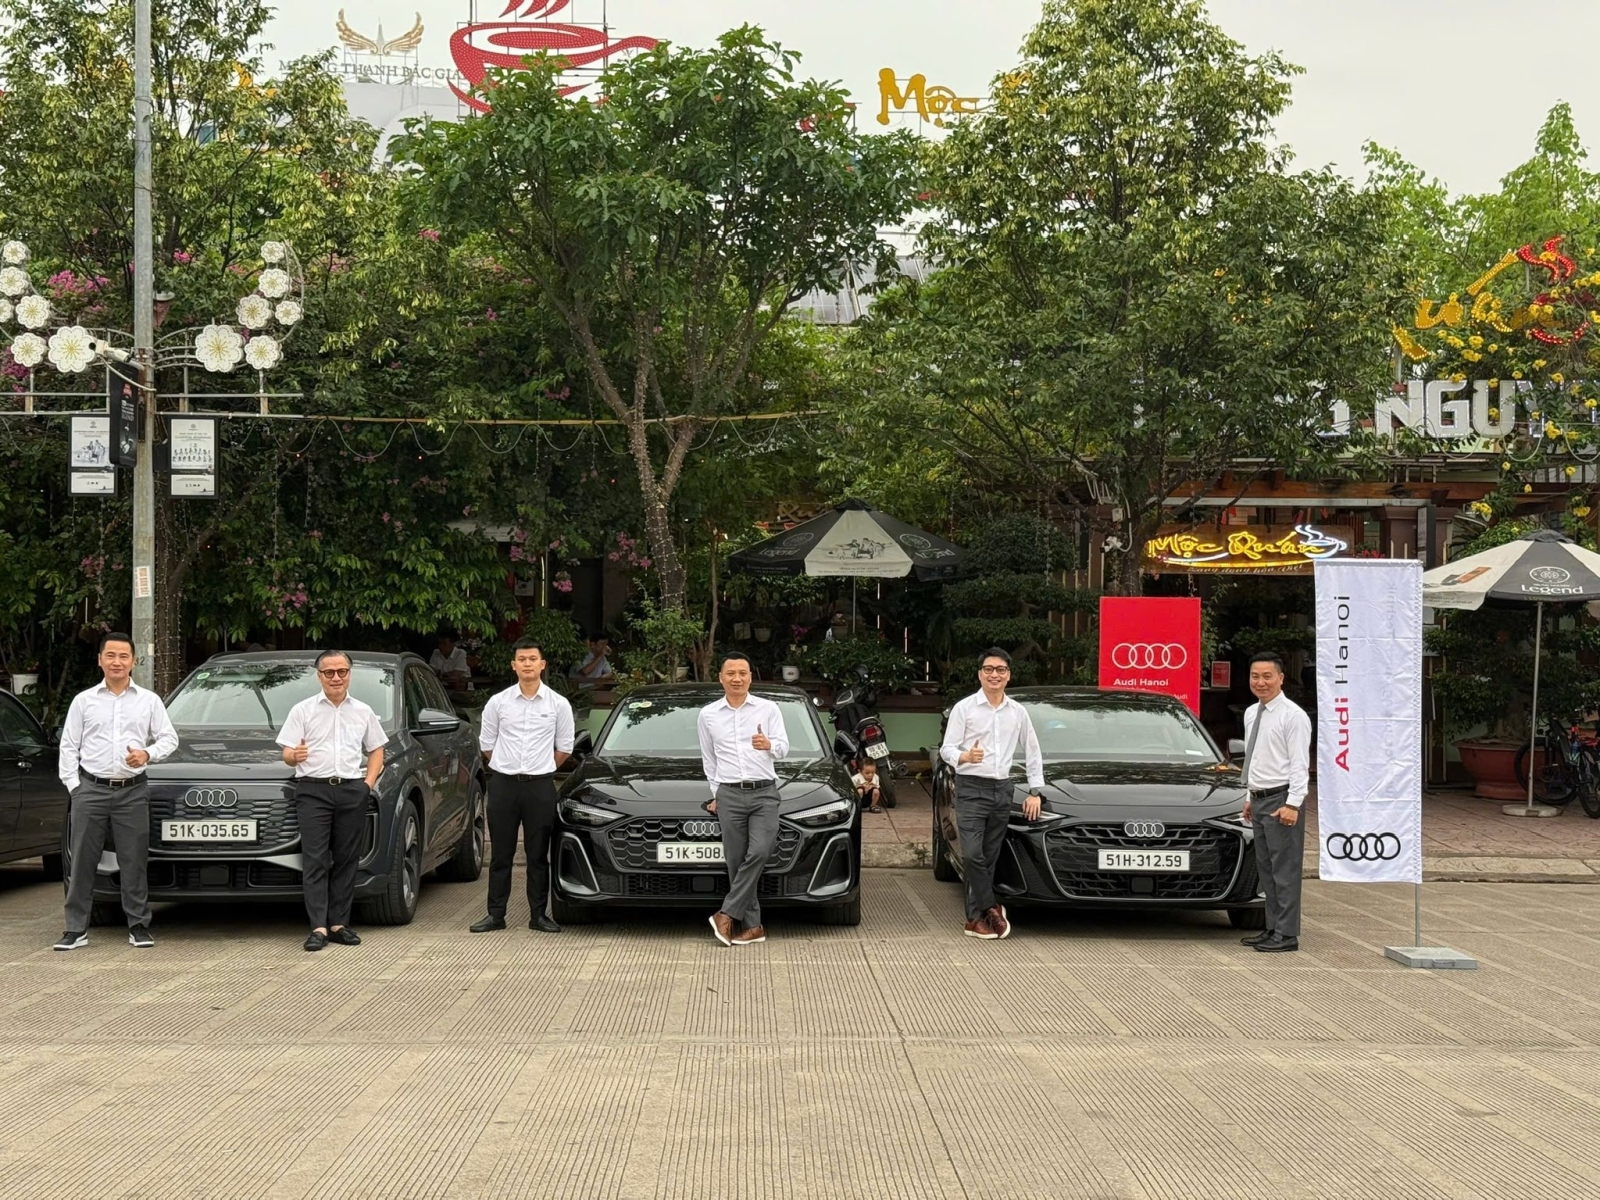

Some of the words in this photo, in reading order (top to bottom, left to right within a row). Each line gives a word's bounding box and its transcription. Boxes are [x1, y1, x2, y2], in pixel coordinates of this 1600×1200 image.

[342, 63, 399, 78] THANH
[876, 68, 981, 128] Mộc
[1148, 533, 1224, 558] Mộc
[1521, 584, 1584, 595] Legend
[1334, 595, 1350, 685] Hanoi
[1113, 678, 1137, 686] Audi
[1139, 678, 1169, 686] Hanoi
[1335, 697, 1350, 772] Audi
[169, 824, 249, 838] 51K-035.65
[665, 846, 725, 859] 51K-508.
[1106, 854, 1182, 867] 51H-312.59
